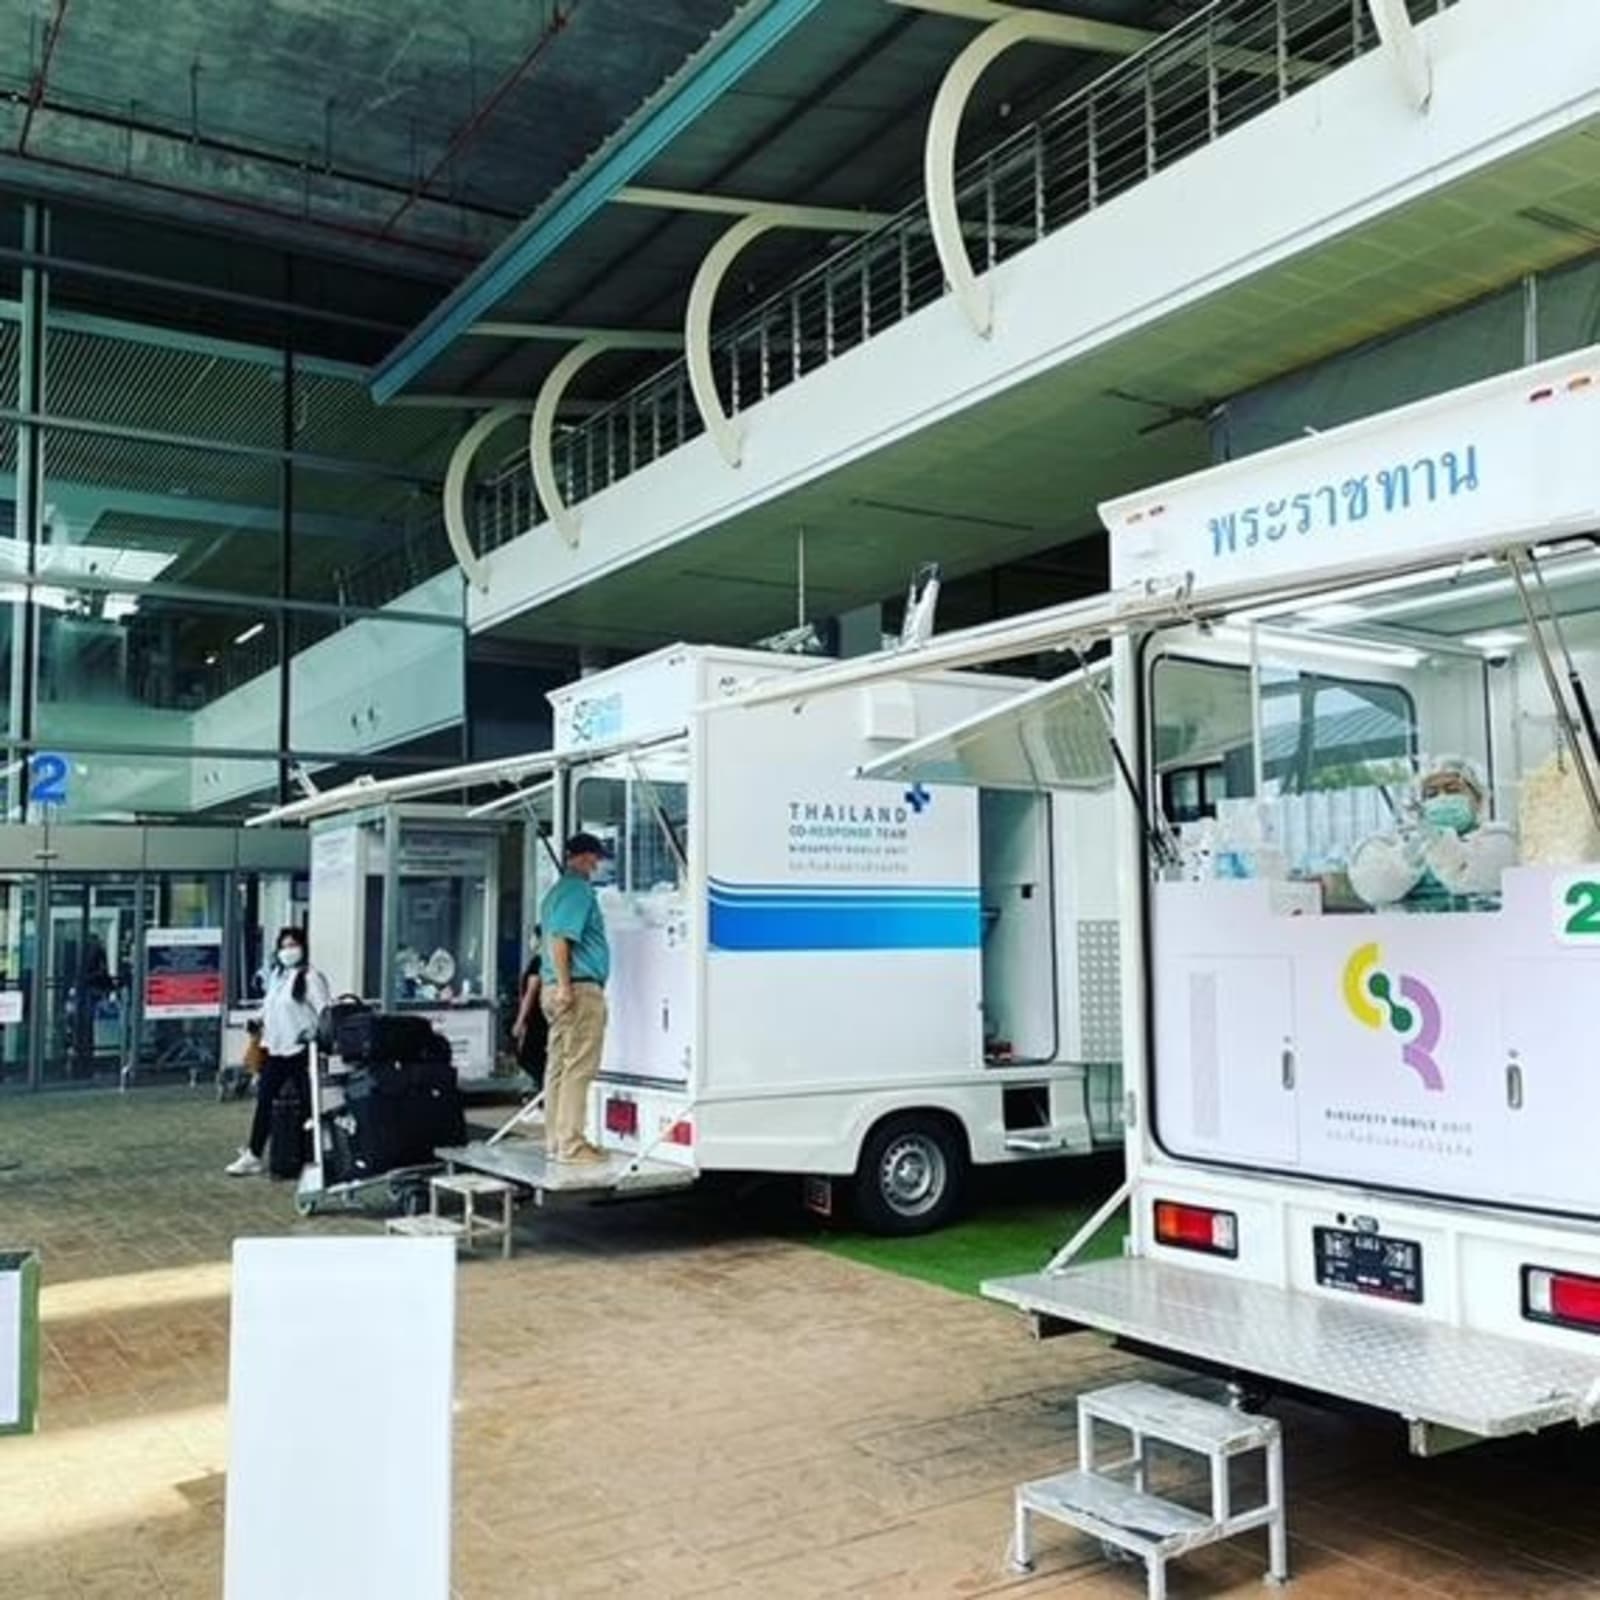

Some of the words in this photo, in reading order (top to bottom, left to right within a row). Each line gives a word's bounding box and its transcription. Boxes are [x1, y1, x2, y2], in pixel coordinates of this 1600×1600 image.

[31, 753, 67, 803] 2
[788, 802, 908, 823] THAILAND
[1564, 881, 1600, 934] 2
